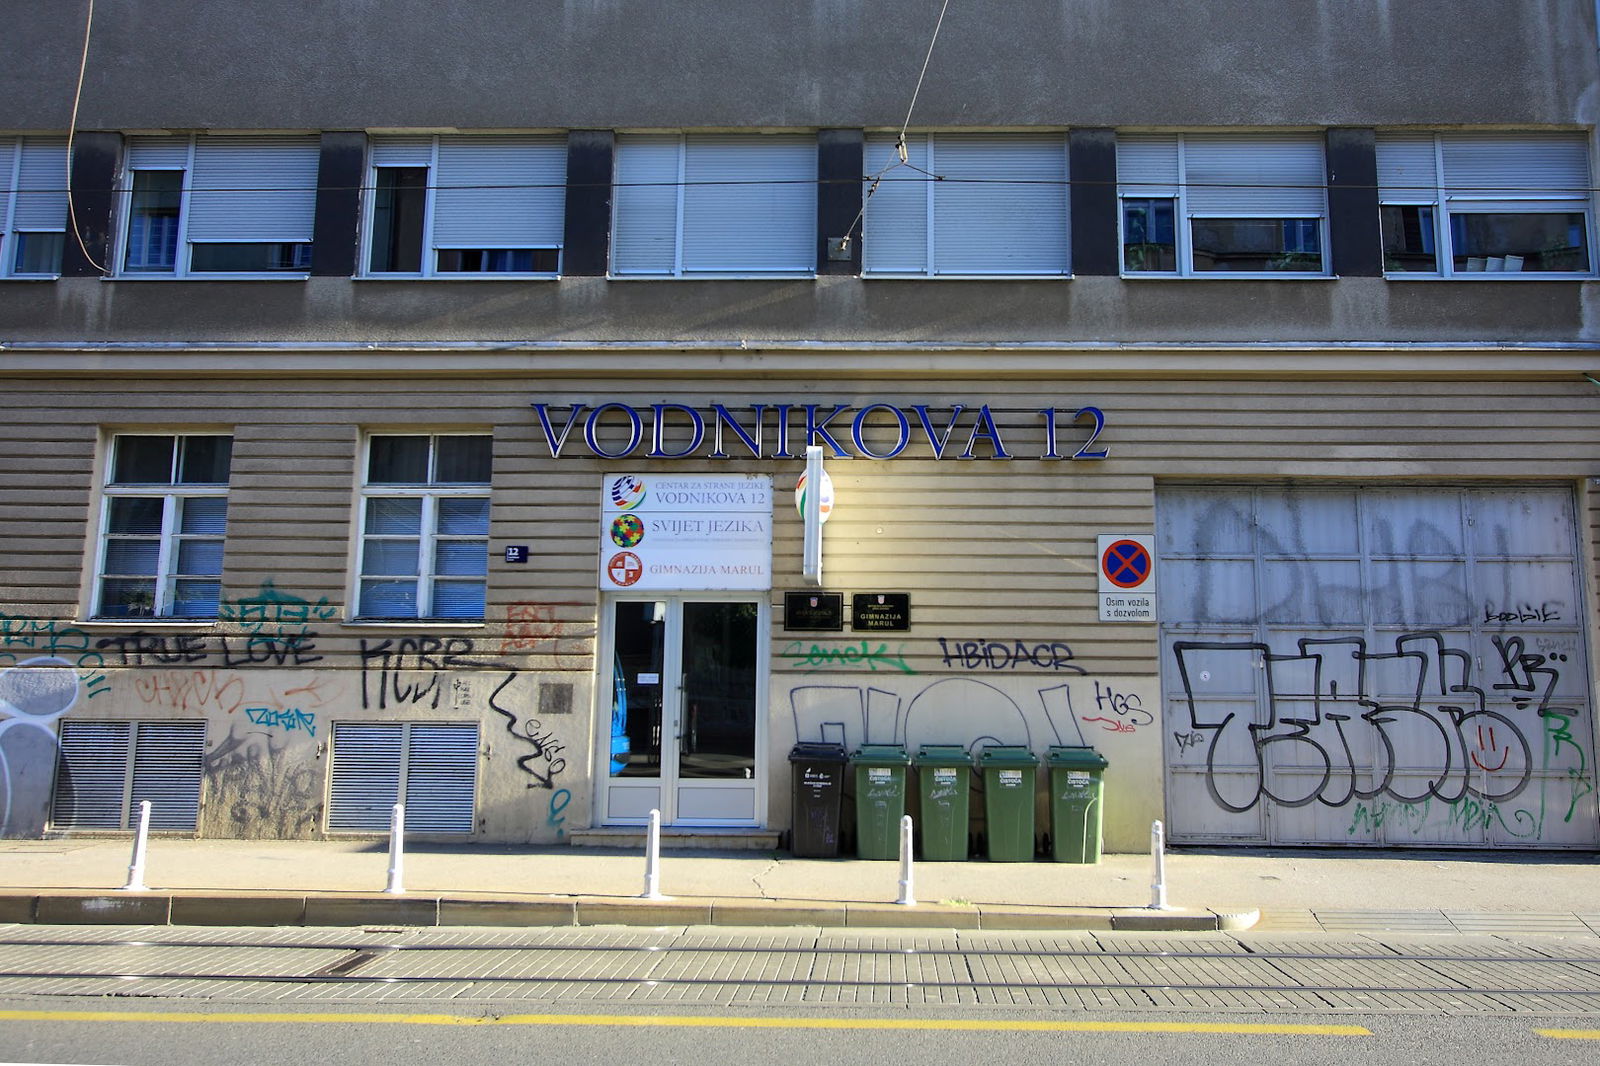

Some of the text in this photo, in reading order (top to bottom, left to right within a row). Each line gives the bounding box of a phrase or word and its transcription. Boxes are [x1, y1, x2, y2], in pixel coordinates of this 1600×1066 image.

[530, 403, 1111, 460] VODNIKOVA 12
[737, 482, 764, 490] JEZIKE
[655, 492, 765, 504] VODNIKOVA 12
[652, 519, 764, 536] SVIJET JEZIKA
[508, 547, 519, 556] 12
[650, 565, 764, 575] GIMNAZIJA MARUL
[1105, 597, 1150, 606] Osim vozila
[1113, 608, 1150, 617] dozvolom
